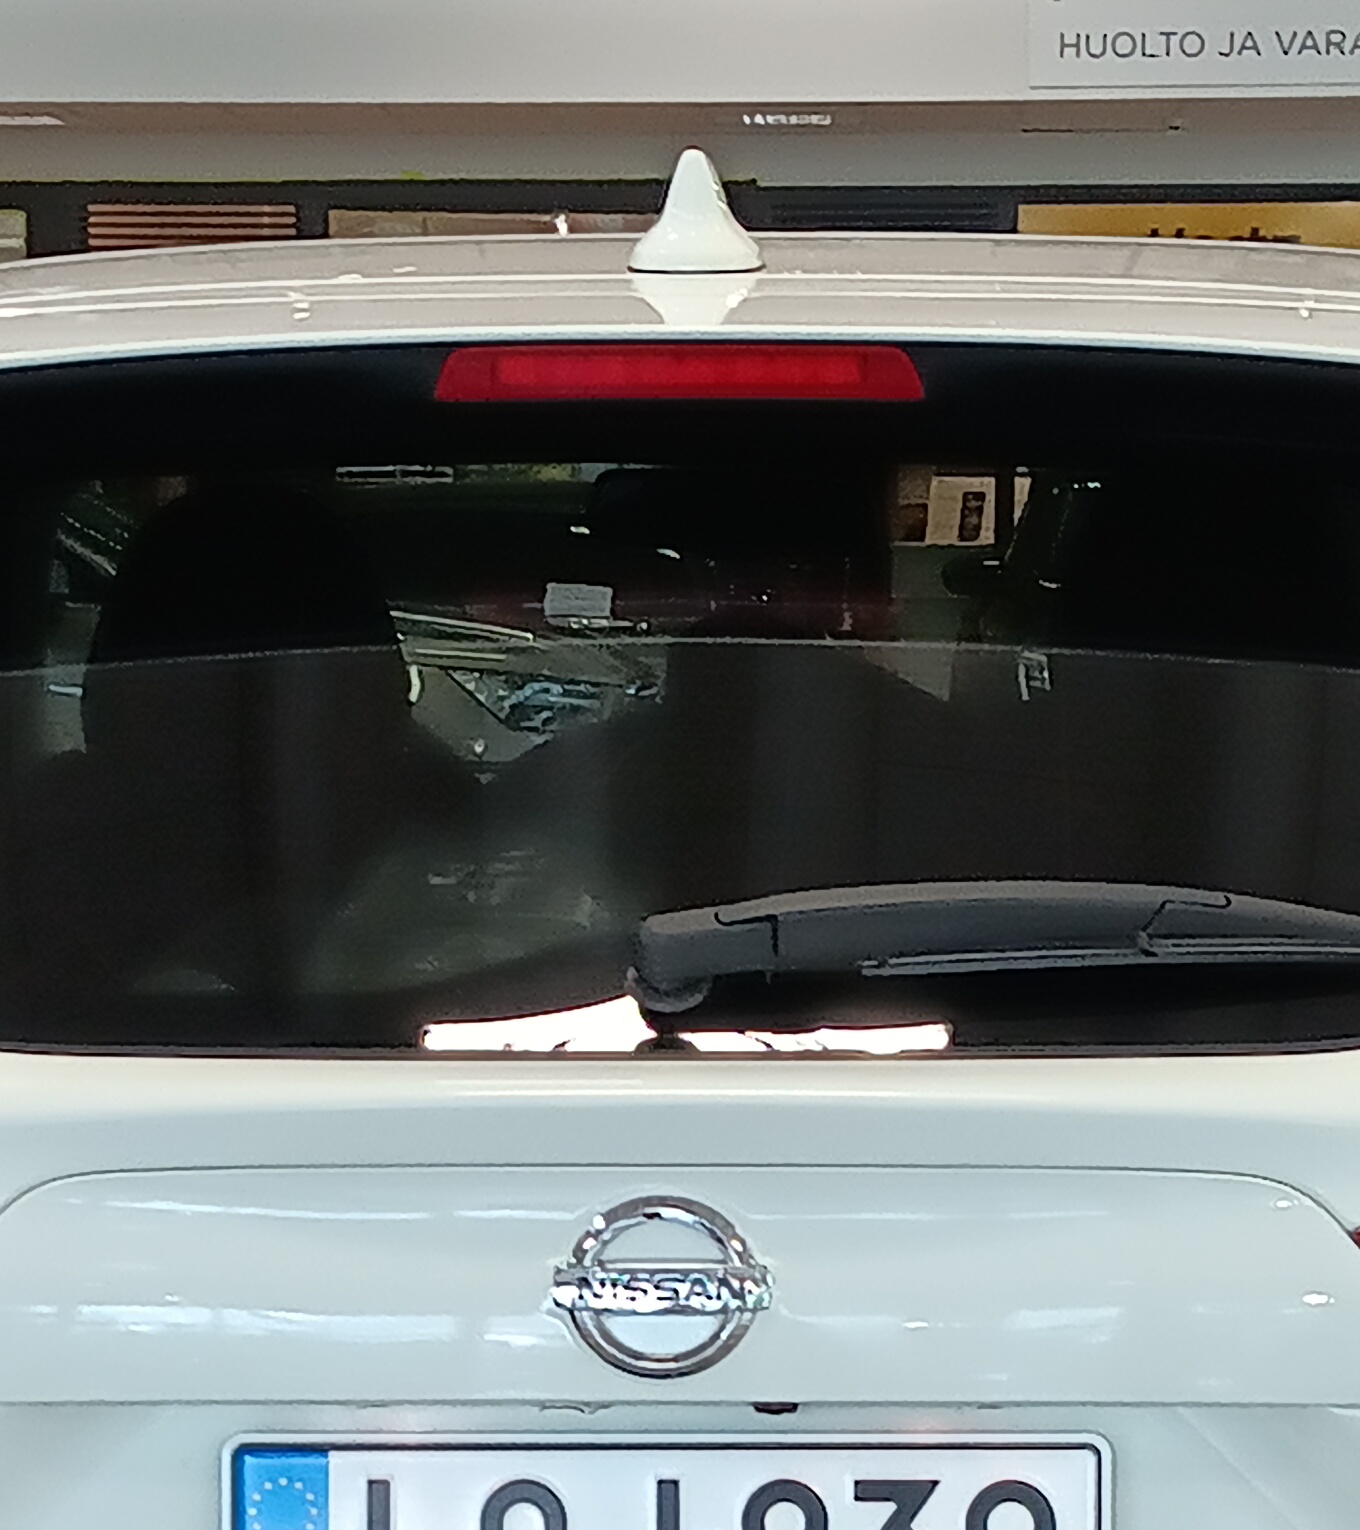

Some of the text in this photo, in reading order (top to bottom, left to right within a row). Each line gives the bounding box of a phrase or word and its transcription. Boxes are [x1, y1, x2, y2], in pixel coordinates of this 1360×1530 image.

[1059, 30, 1206, 59] HUOLTO
[1218, 31, 1261, 57] JA
[572, 1270, 764, 1308] NISSAN
